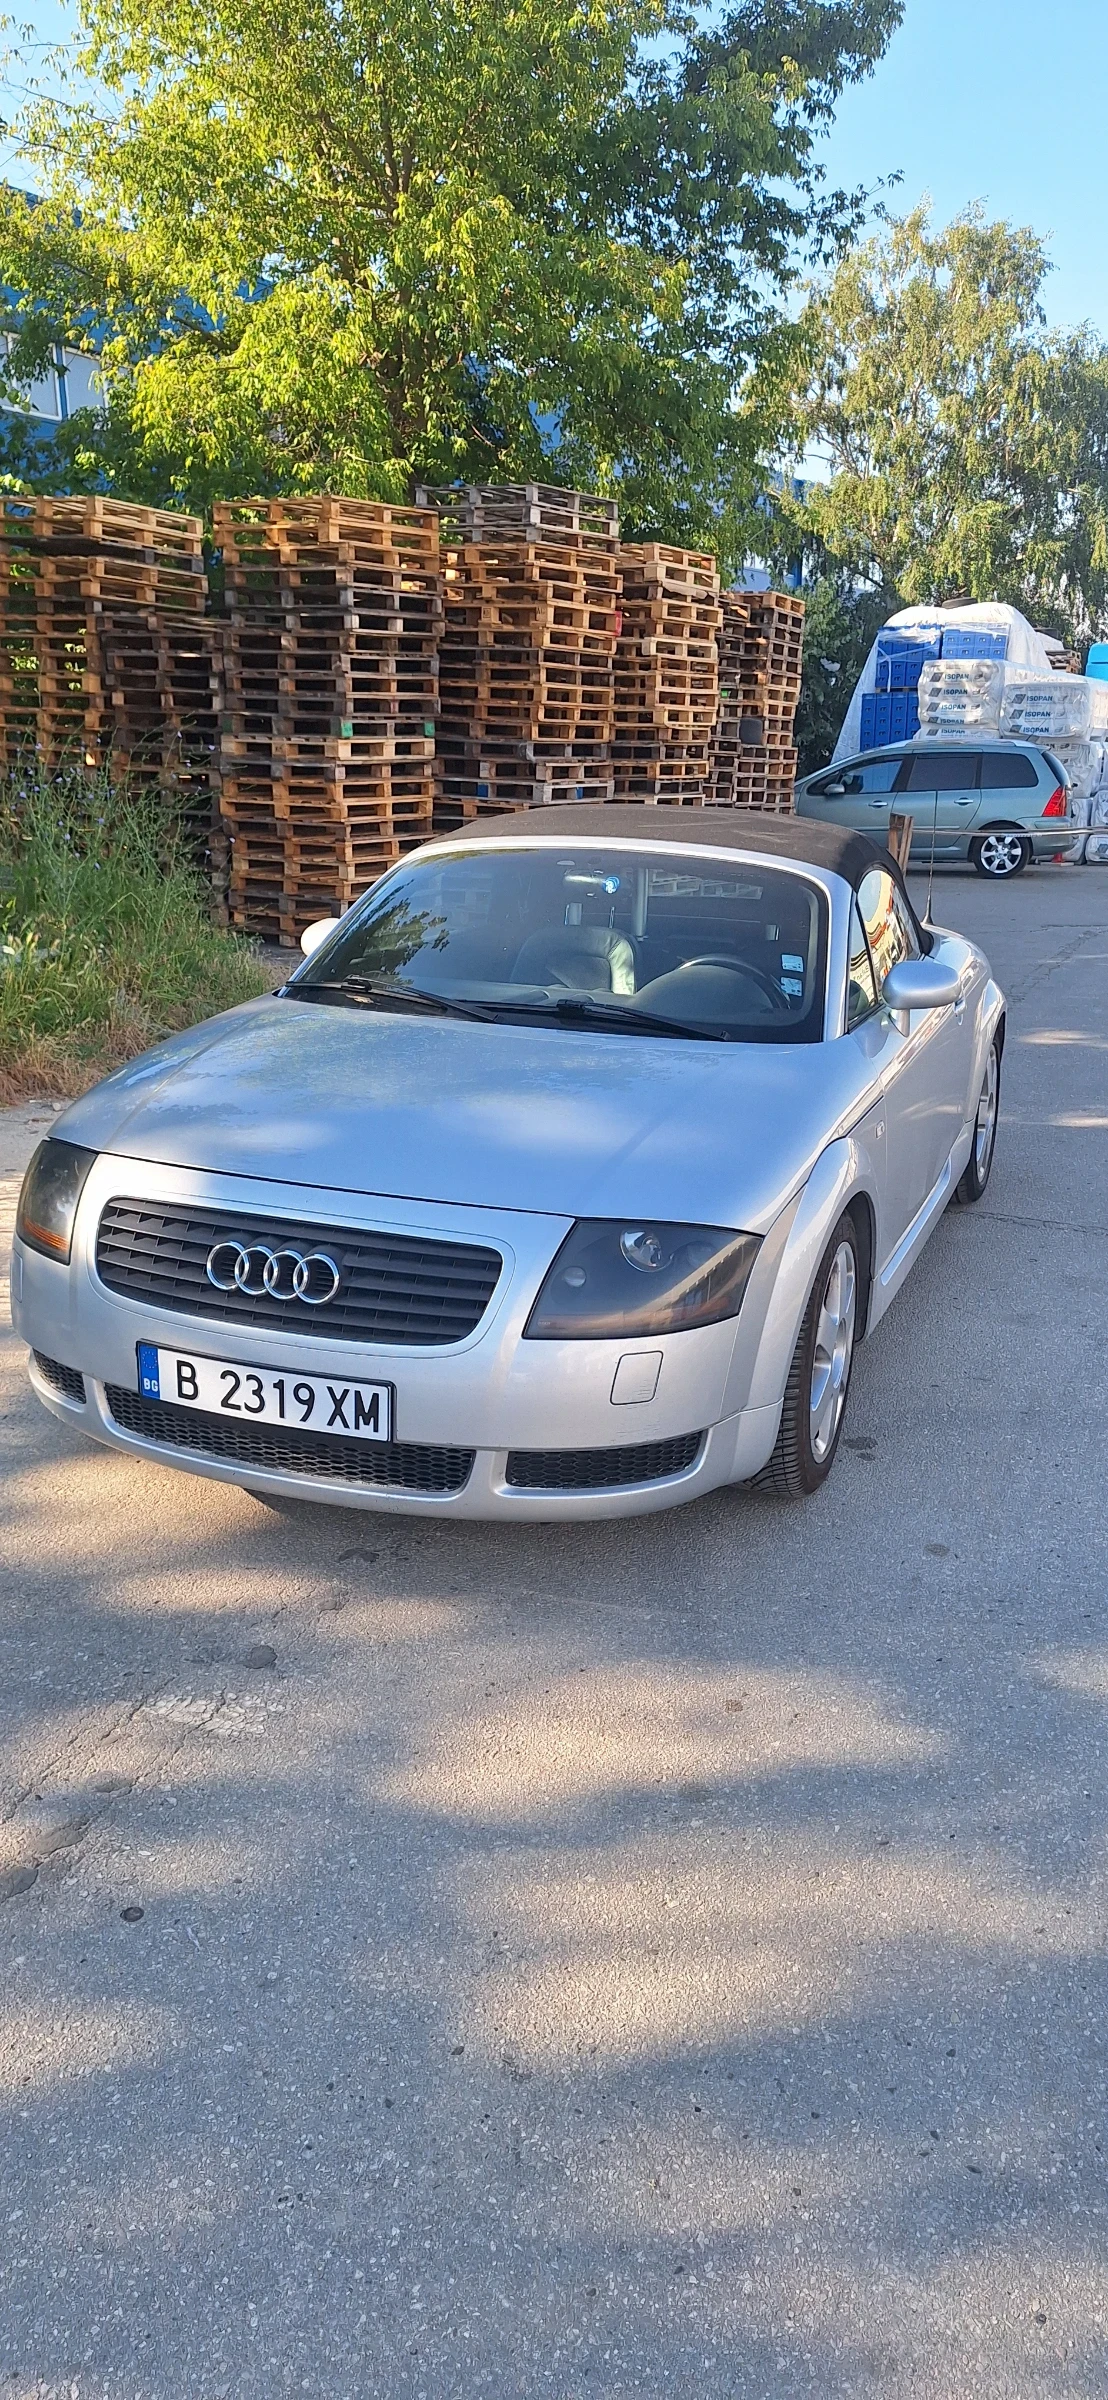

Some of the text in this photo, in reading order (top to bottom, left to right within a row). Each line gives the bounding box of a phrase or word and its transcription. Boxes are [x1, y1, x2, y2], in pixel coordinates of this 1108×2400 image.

[143, 1377, 159, 1392] BG
[176, 1359, 380, 1433] B 2319 XM
